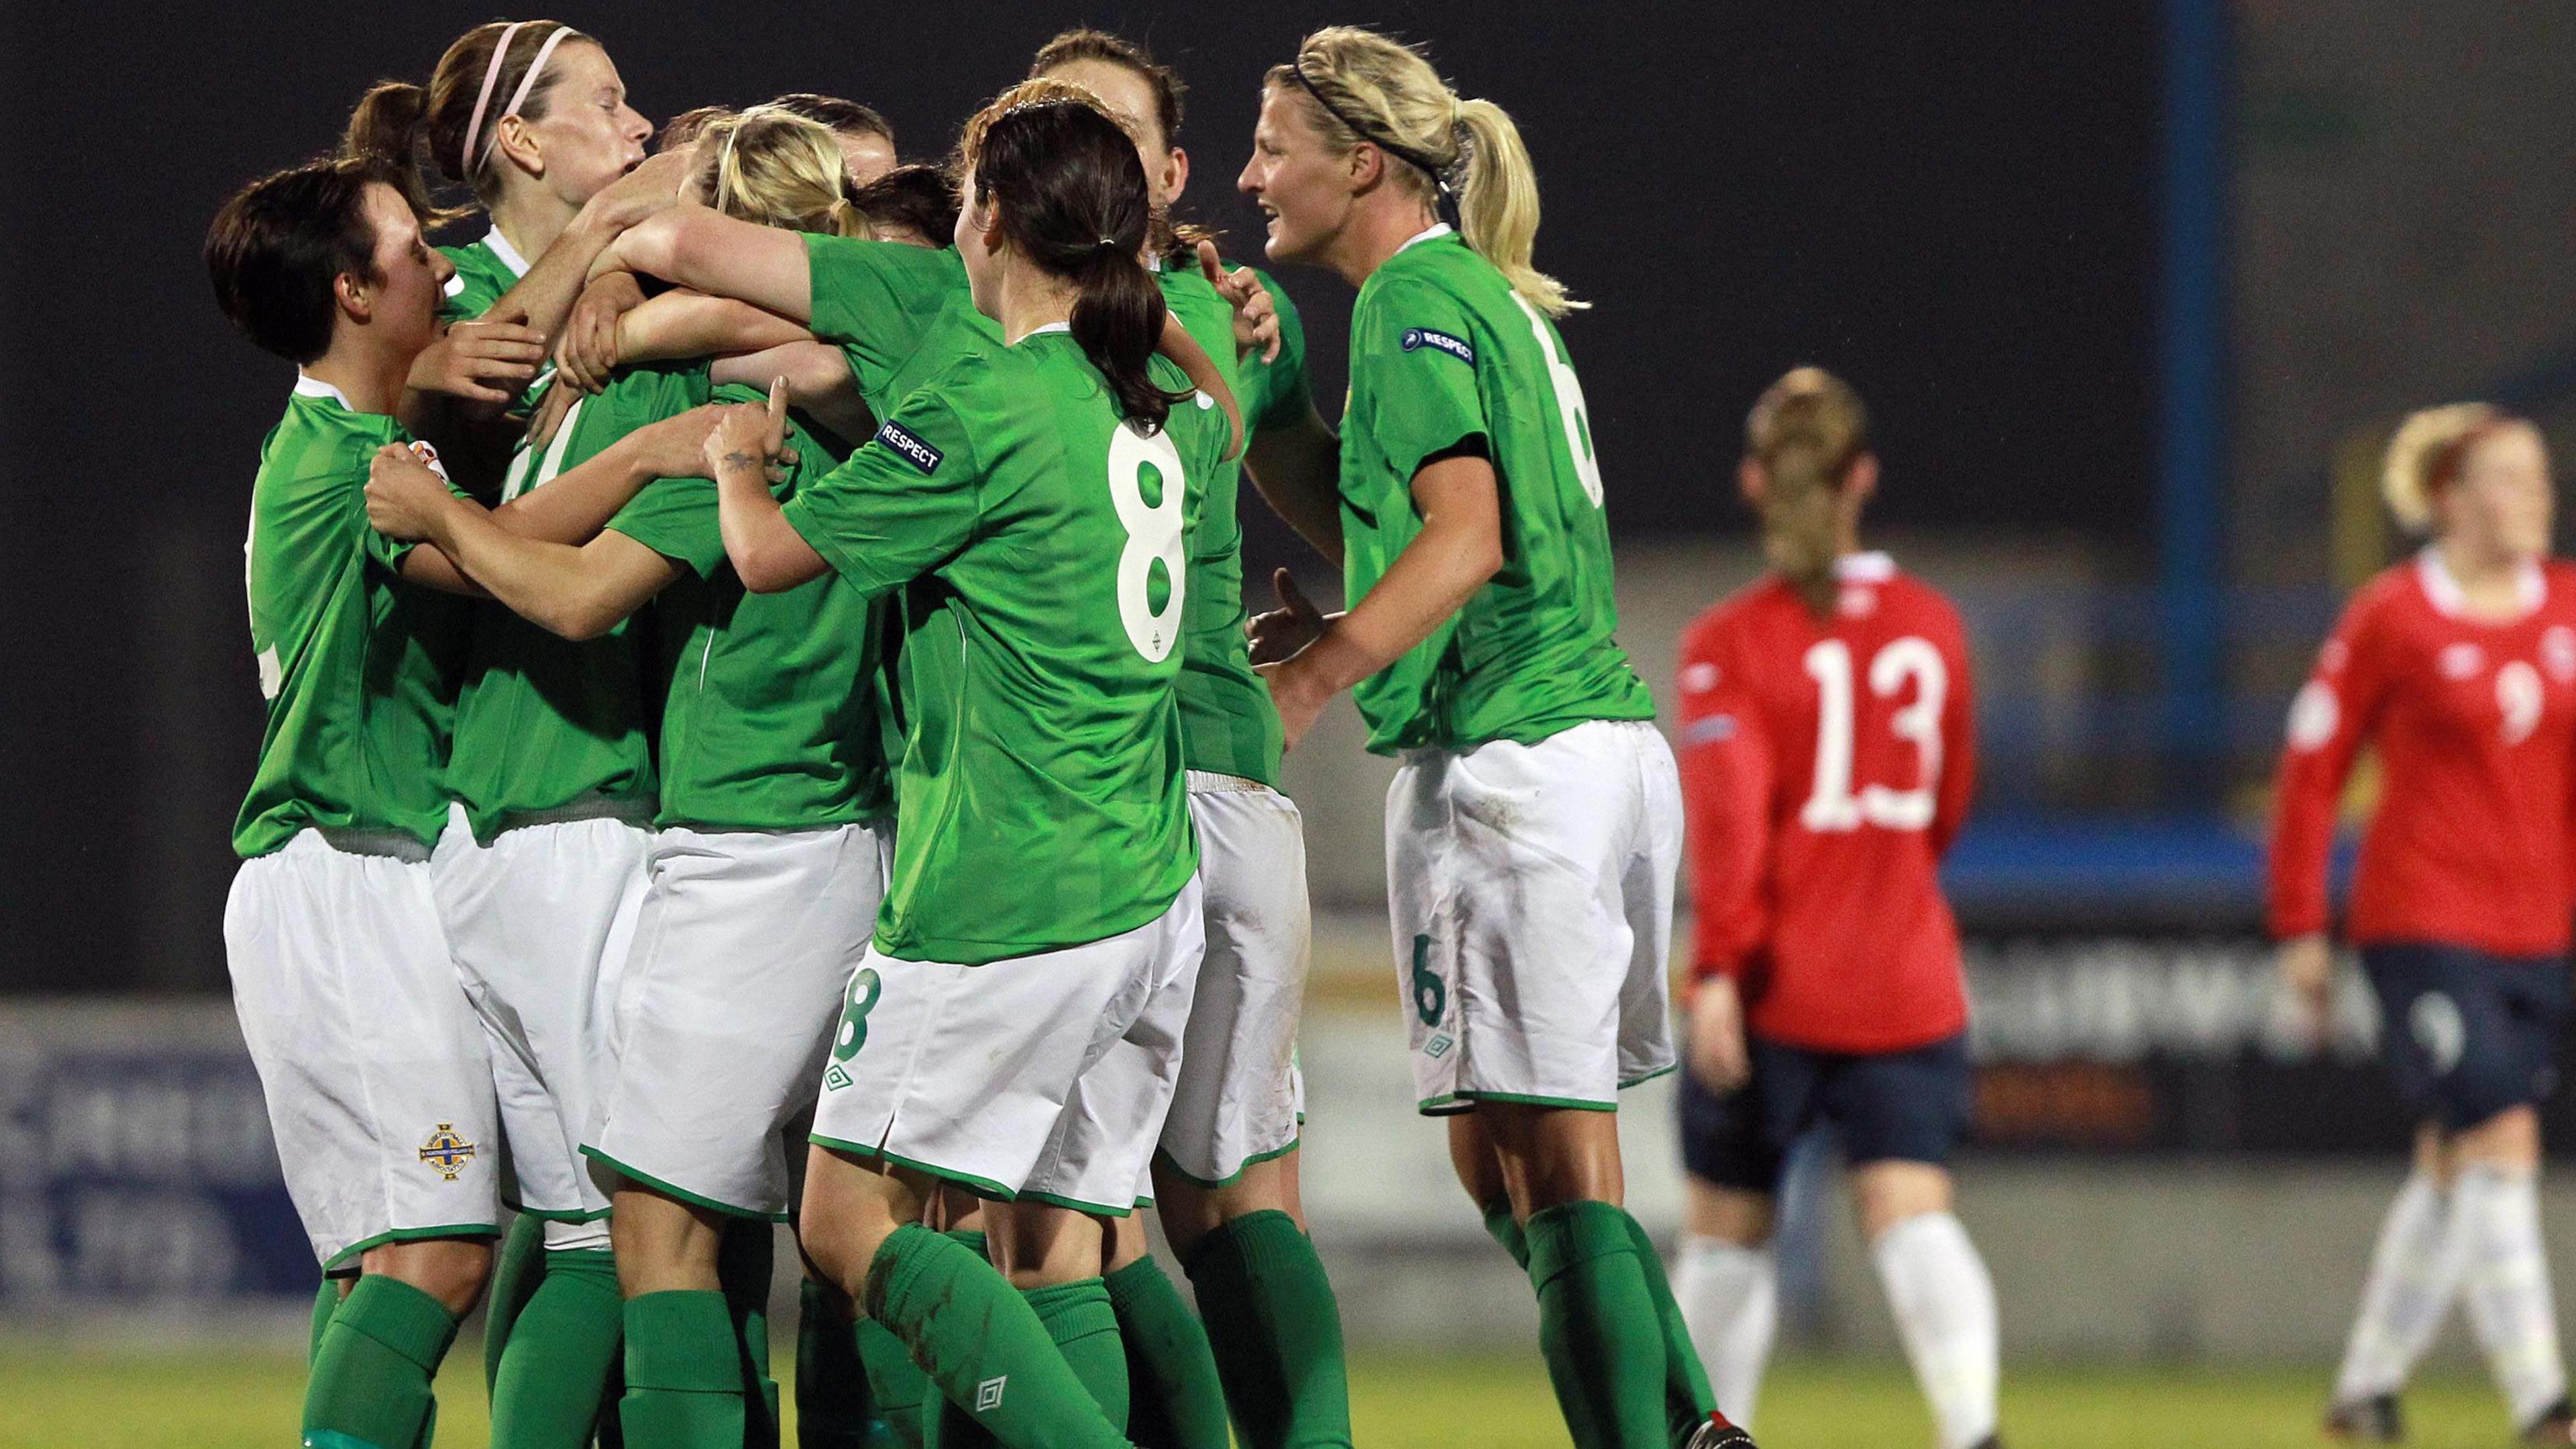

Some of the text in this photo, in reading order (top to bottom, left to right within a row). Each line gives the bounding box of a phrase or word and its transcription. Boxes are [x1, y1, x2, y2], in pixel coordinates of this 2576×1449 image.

[882, 425, 938, 468] RESPECT
[1108, 420, 1185, 663] 8
[1800, 636, 1948, 832] 13
[2496, 660, 2544, 745] 9
[834, 968, 881, 1062] 8
[1413, 934, 1445, 1028] 6
